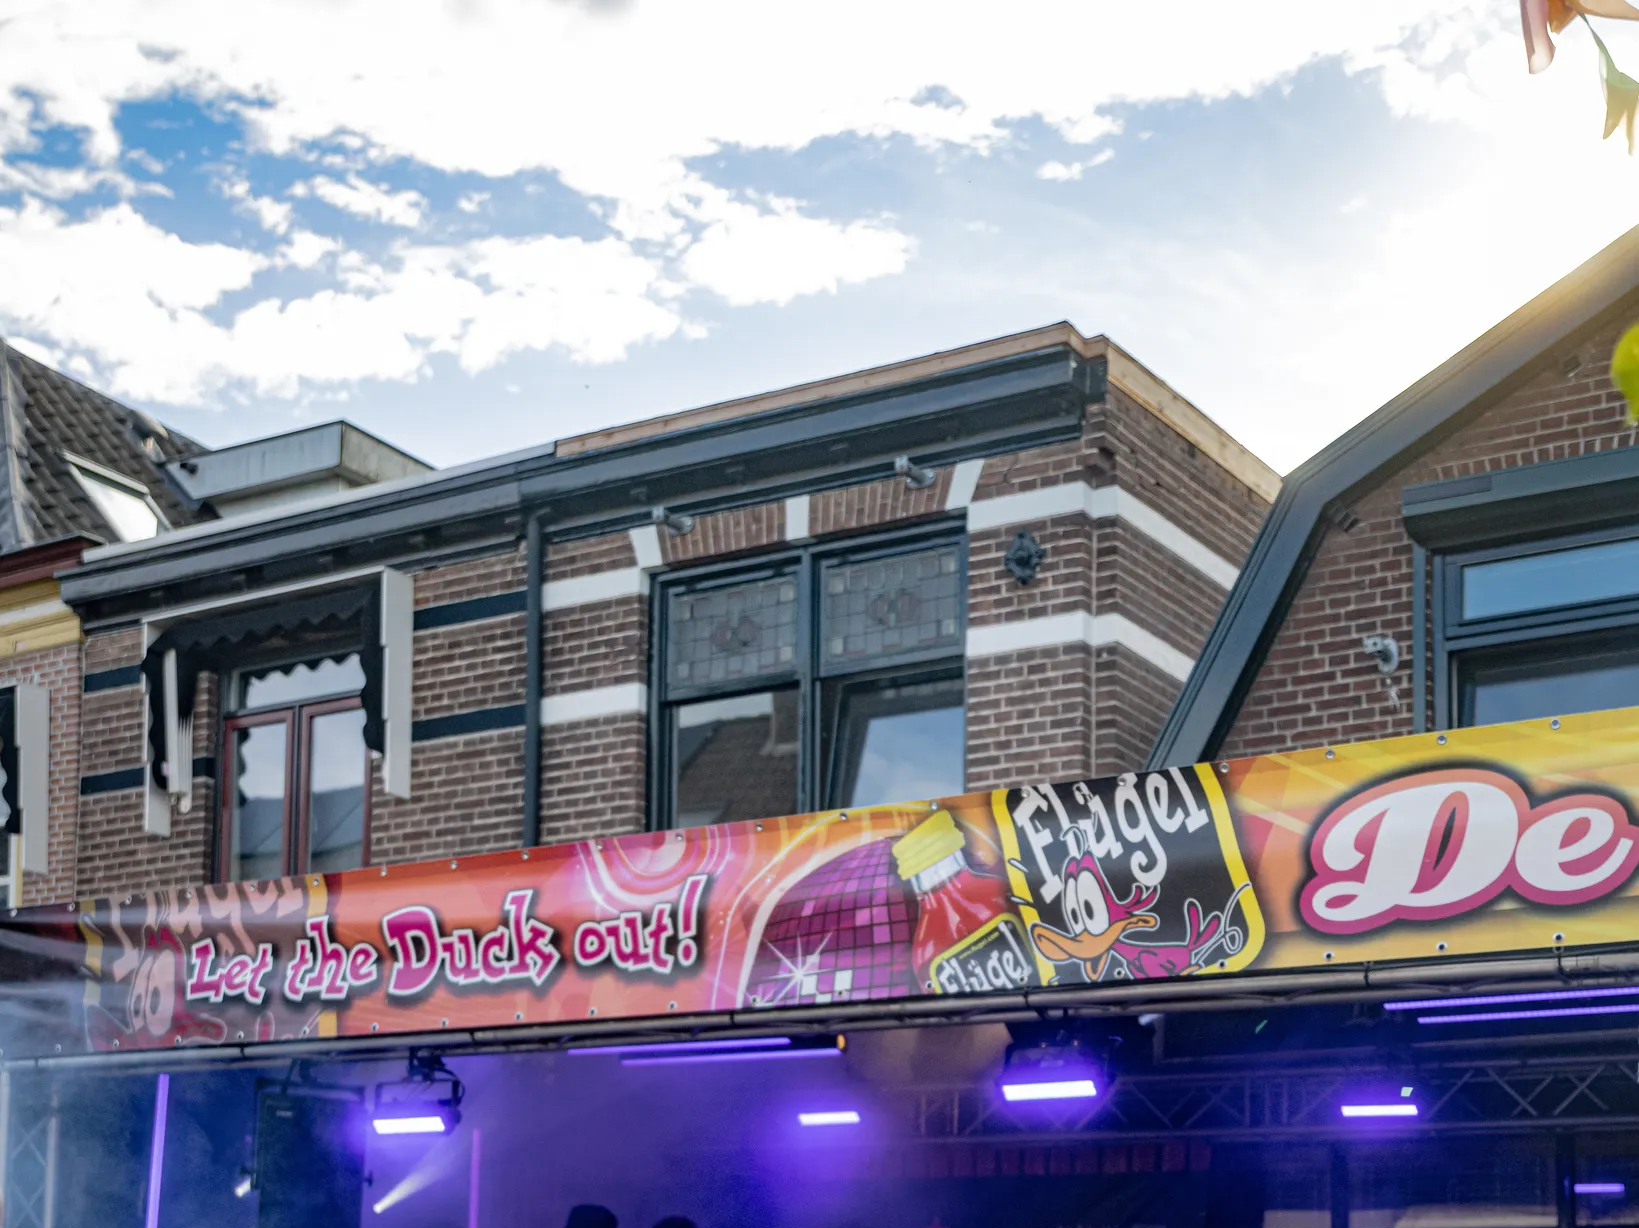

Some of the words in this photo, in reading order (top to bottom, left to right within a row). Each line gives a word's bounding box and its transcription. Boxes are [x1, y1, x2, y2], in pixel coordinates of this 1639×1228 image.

[1013, 767, 1209, 904] Flügel
[1304, 774, 1638, 929] De
[187, 937, 273, 1004] Let
[284, 915, 378, 1001] the
[382, 889, 560, 995] Duck
[574, 874, 707, 974] out!
